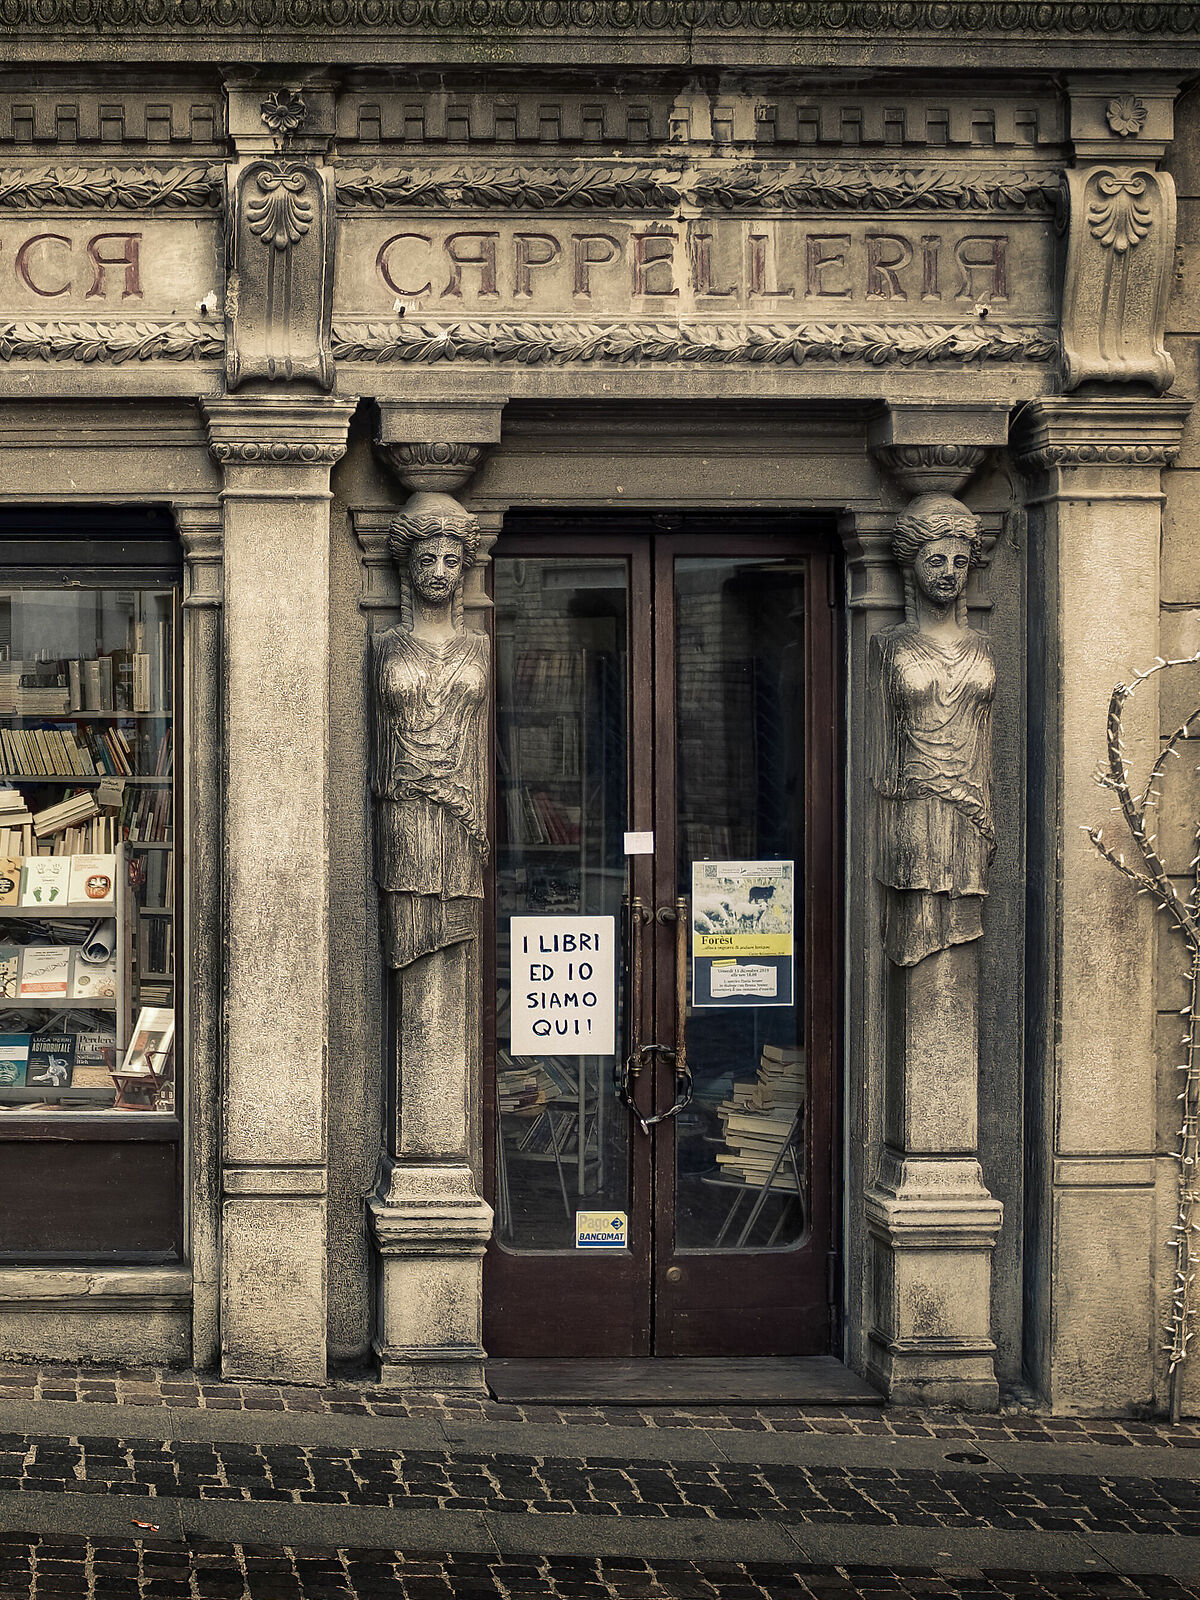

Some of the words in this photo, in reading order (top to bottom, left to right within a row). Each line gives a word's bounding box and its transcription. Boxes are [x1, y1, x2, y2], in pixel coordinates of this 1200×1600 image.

[374, 232, 1009, 301] CAPPELLERIA
[523, 936, 528, 953] I
[540, 933, 600, 953] LIBRI
[530, 963, 554, 981] ED
[568, 963, 593, 980] IO
[526, 991, 598, 1009] SIAMO
[532, 1018, 592, 1036] QUI!
[579, 1214, 609, 1231] Pago
[579, 1232, 625, 1241] BANCOMAT
